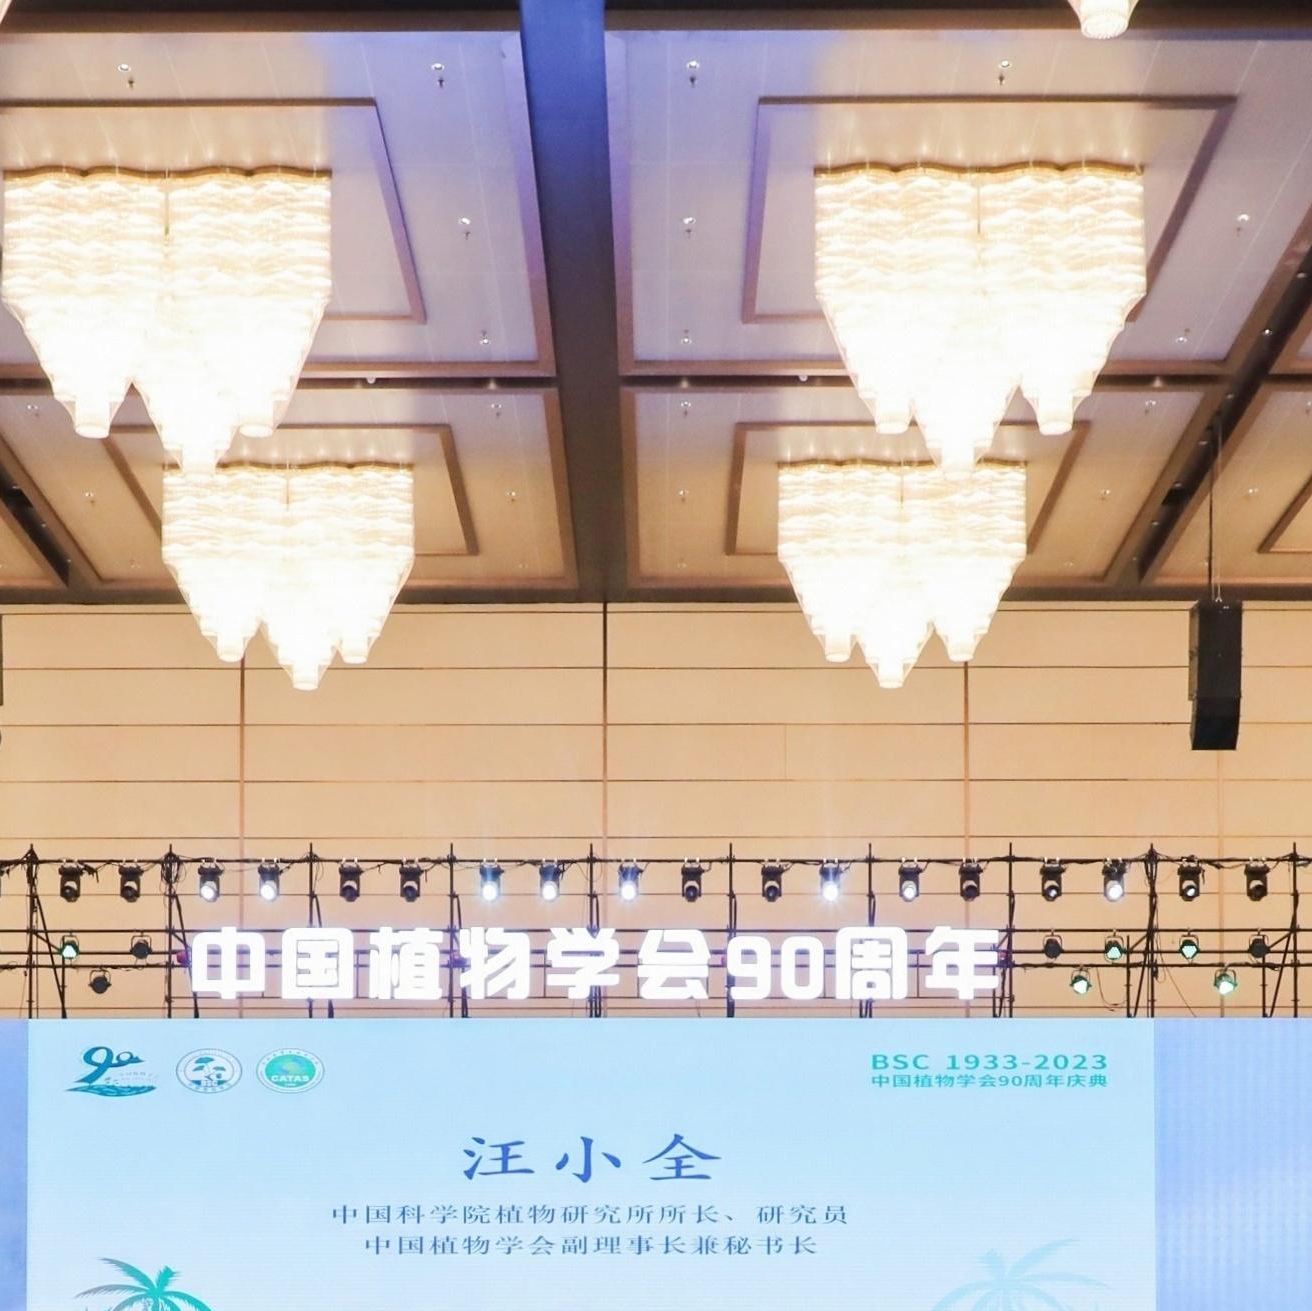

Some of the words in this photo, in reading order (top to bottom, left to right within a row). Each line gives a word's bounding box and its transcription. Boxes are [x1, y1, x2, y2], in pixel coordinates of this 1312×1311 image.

[191, 926, 1000, 1000] 中国植物学会90周年
[872, 1054, 930, 1070] BSC
[946, 1054, 1108, 1070] 1933-2023
[872, 1074, 1108, 1088] 中国植物学会90周年庆典
[462, 1133, 722, 1184] 汪小全
[365, 1235, 818, 1256] 中国植物学会副理事长兼秘书长
